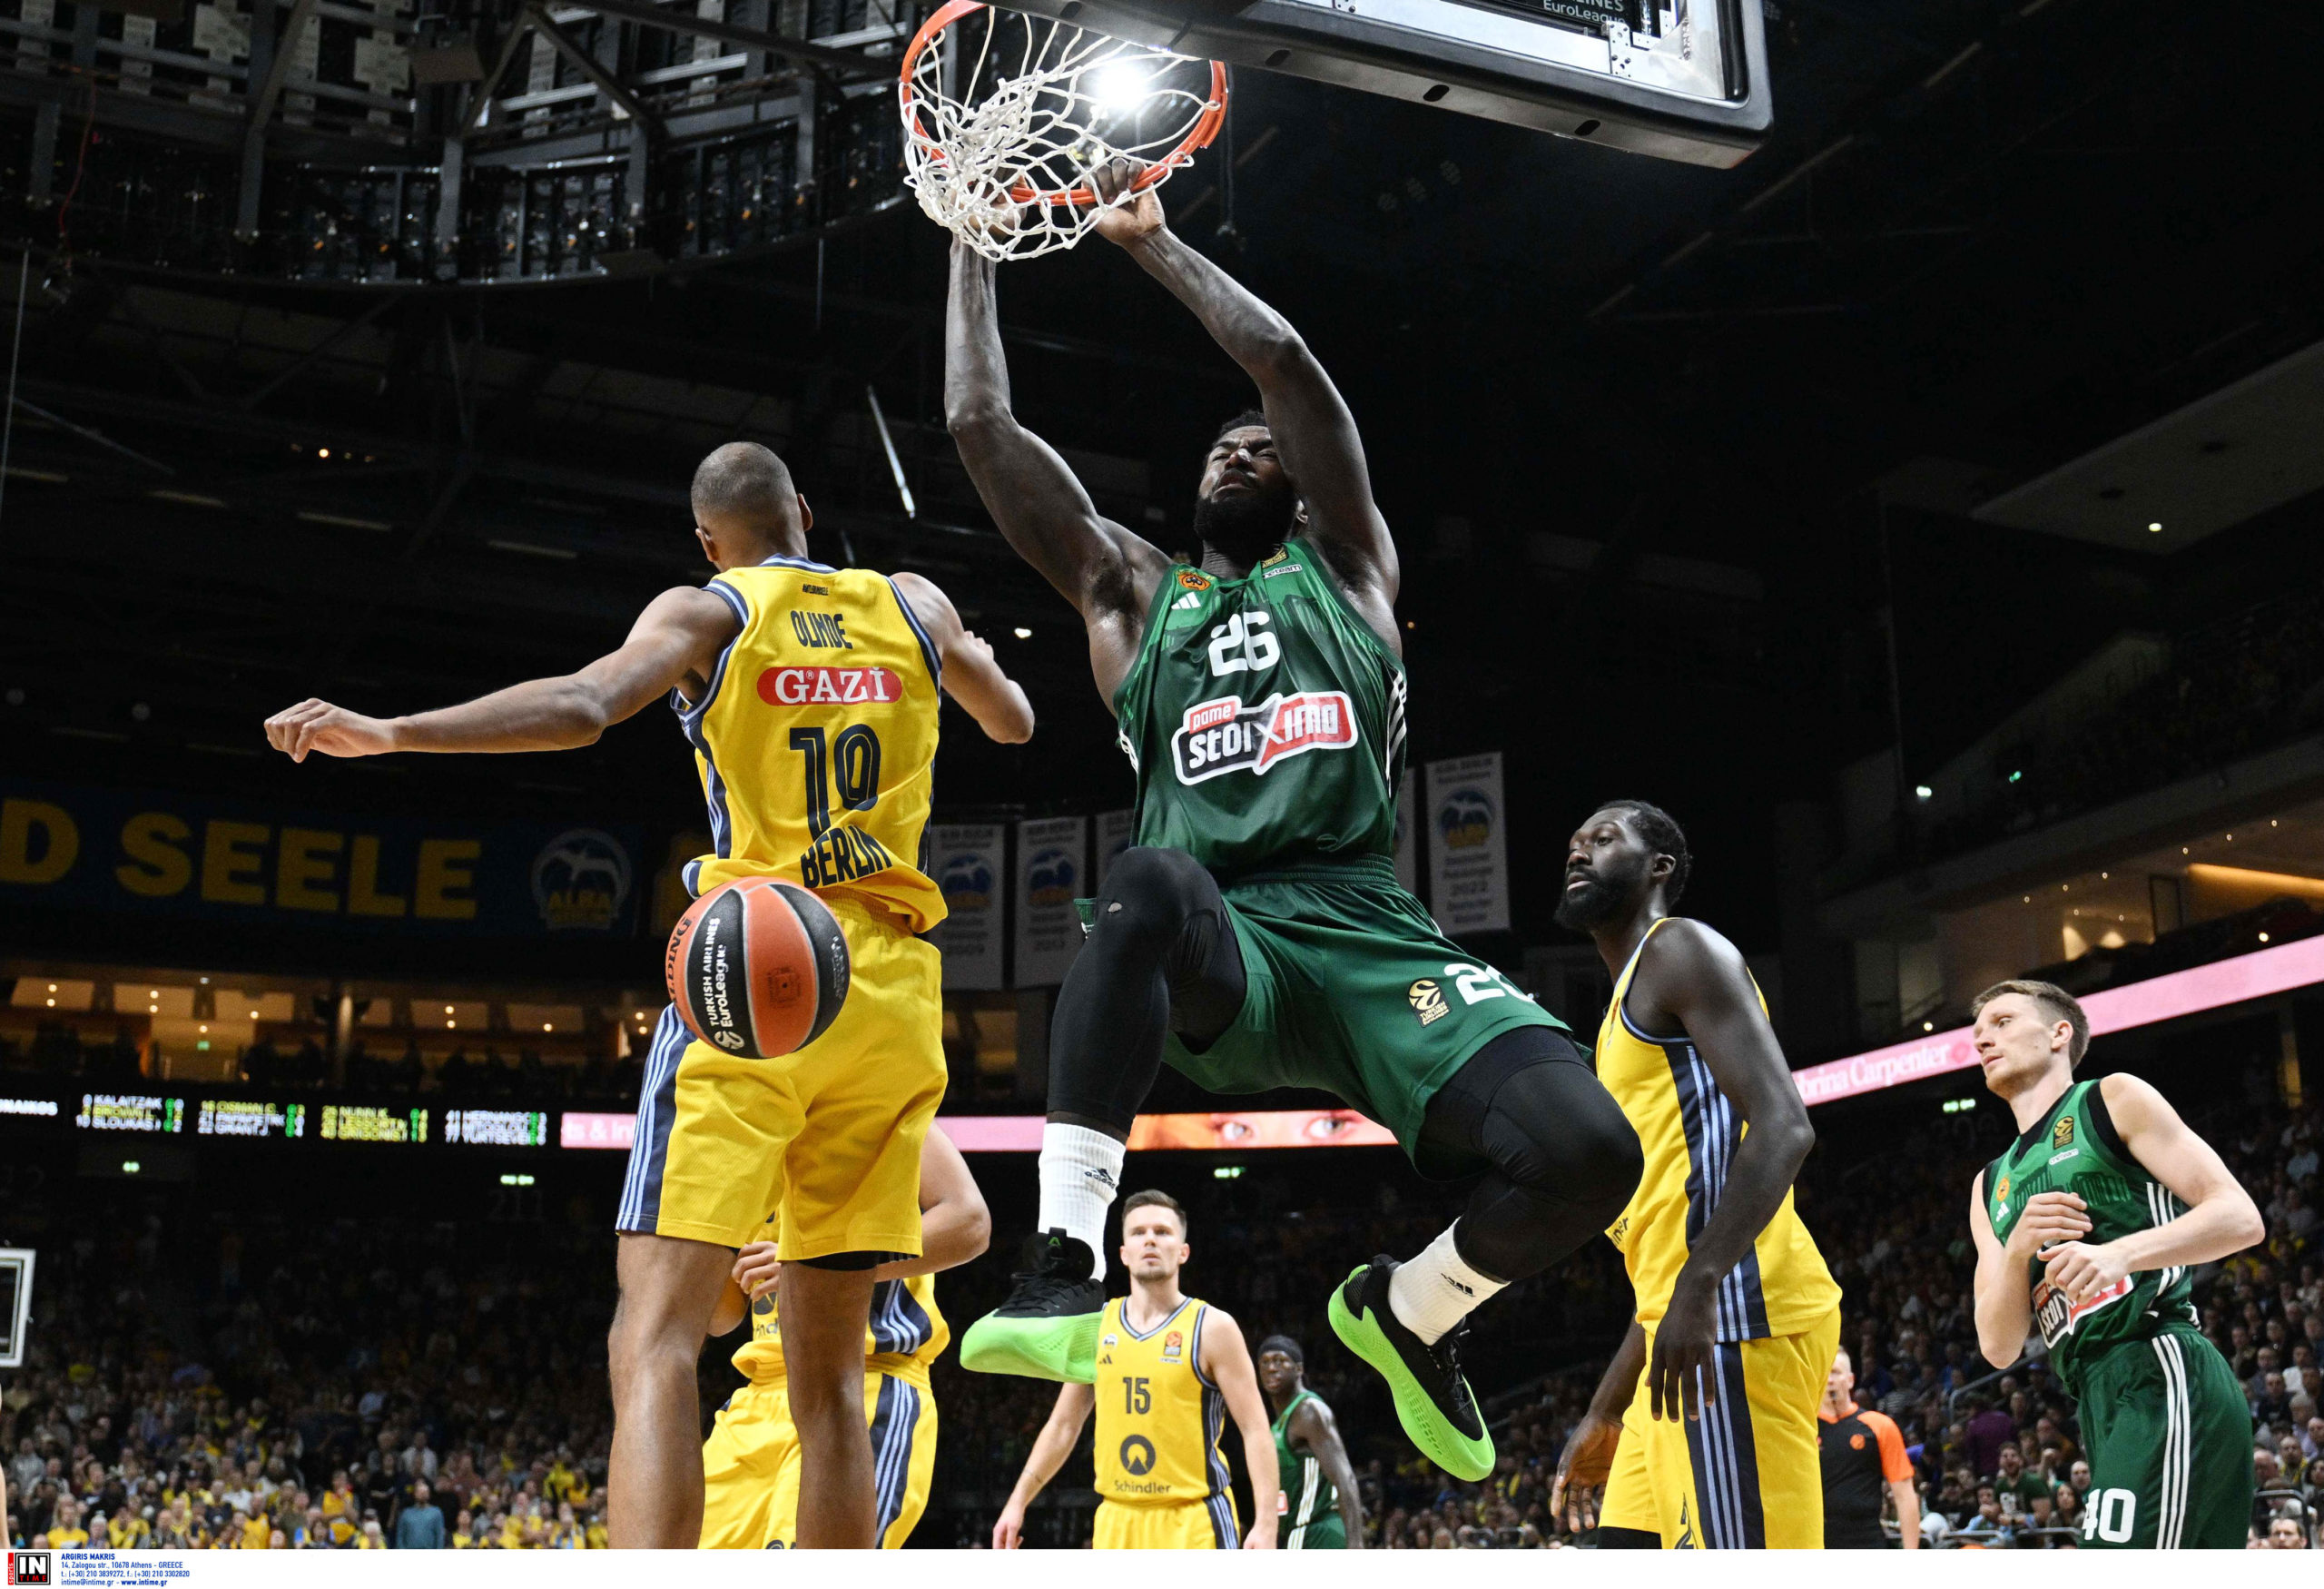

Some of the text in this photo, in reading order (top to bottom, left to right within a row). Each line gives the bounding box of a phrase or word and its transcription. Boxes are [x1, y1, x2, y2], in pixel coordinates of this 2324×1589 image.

[790, 609, 853, 649] OLINDE
[1208, 611, 1280, 676] 26
[1192, 705, 1232, 728] pame
[789, 724, 881, 843] 10
[0, 798, 482, 920] D SEELE
[800, 824, 893, 889] BERLIN
[703, 917, 724, 1027] TURKISH AIRLINES
[714, 944, 734, 1027] EuroLeague
[1849, 1044, 1952, 1087] Carpenter
[1084, 1171, 1117, 1189] adidas
[1122, 1377, 1151, 1415] 15
[1113, 1480, 1171, 1495] Schindler
[2082, 1487, 2136, 1544] 40
